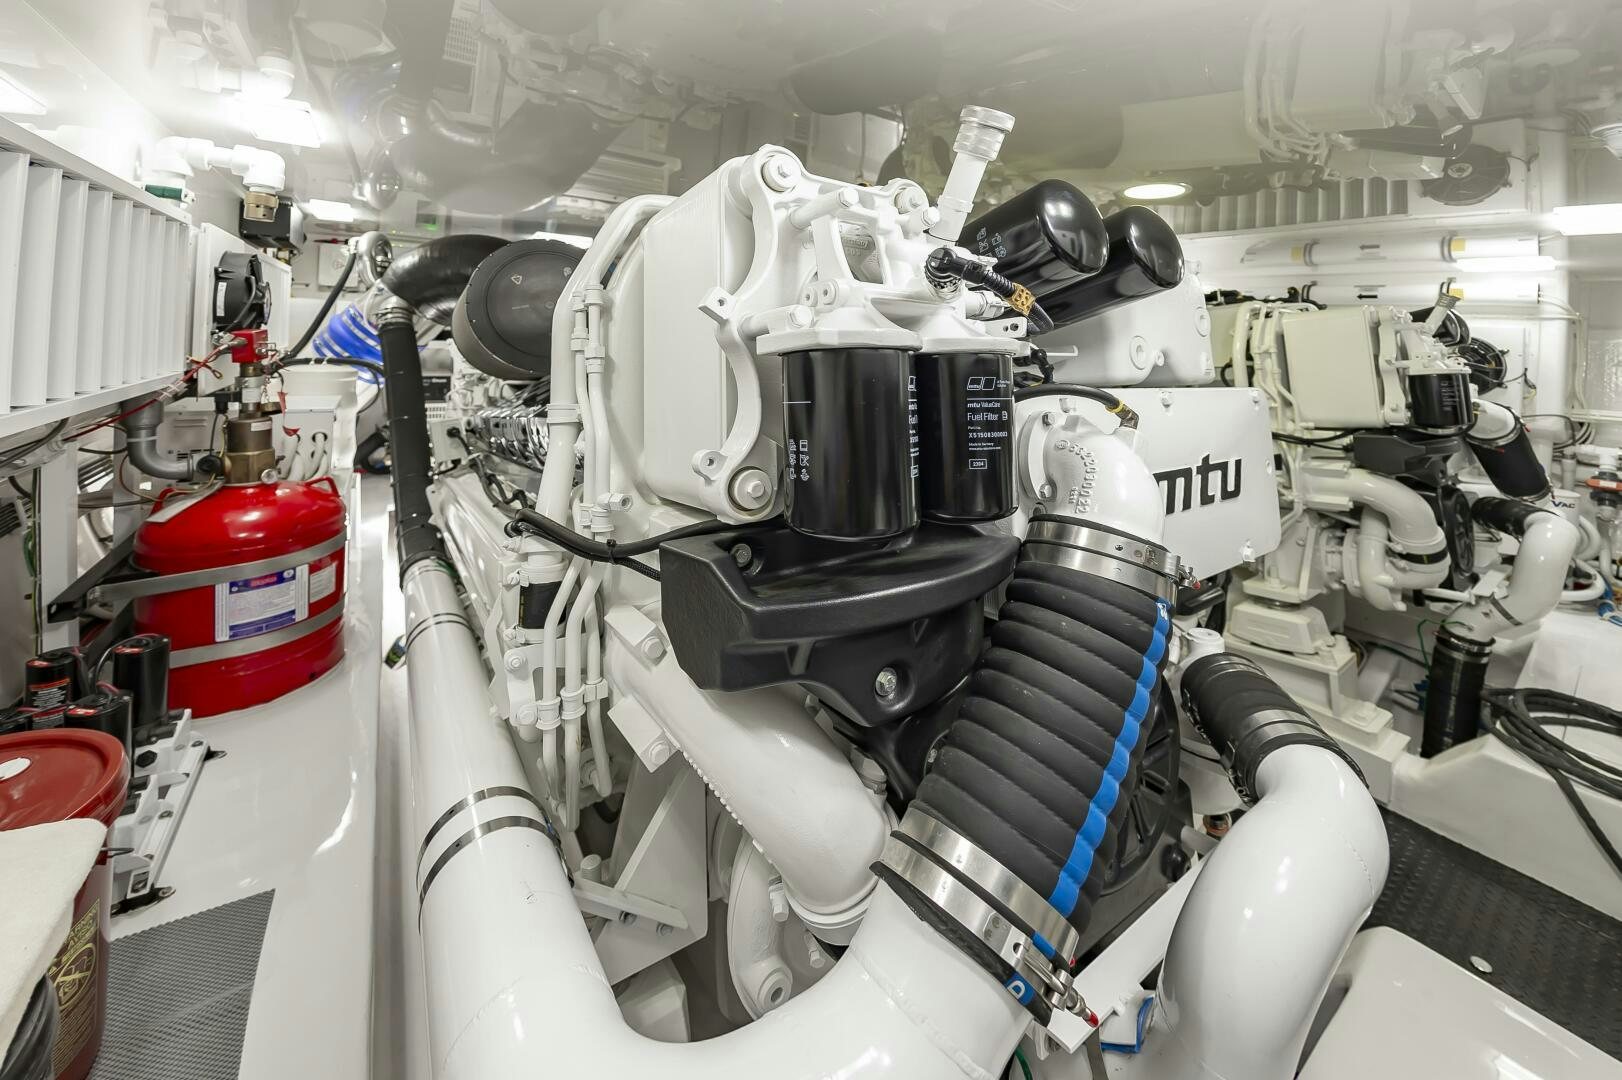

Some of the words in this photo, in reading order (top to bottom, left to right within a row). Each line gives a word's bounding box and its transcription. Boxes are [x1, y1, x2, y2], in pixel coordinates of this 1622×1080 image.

[967, 412, 983, 421] Fuel
[984, 412, 999, 421] Filter
[1152, 453, 1243, 516] mtu
[1551, 500, 1576, 509] VAC
